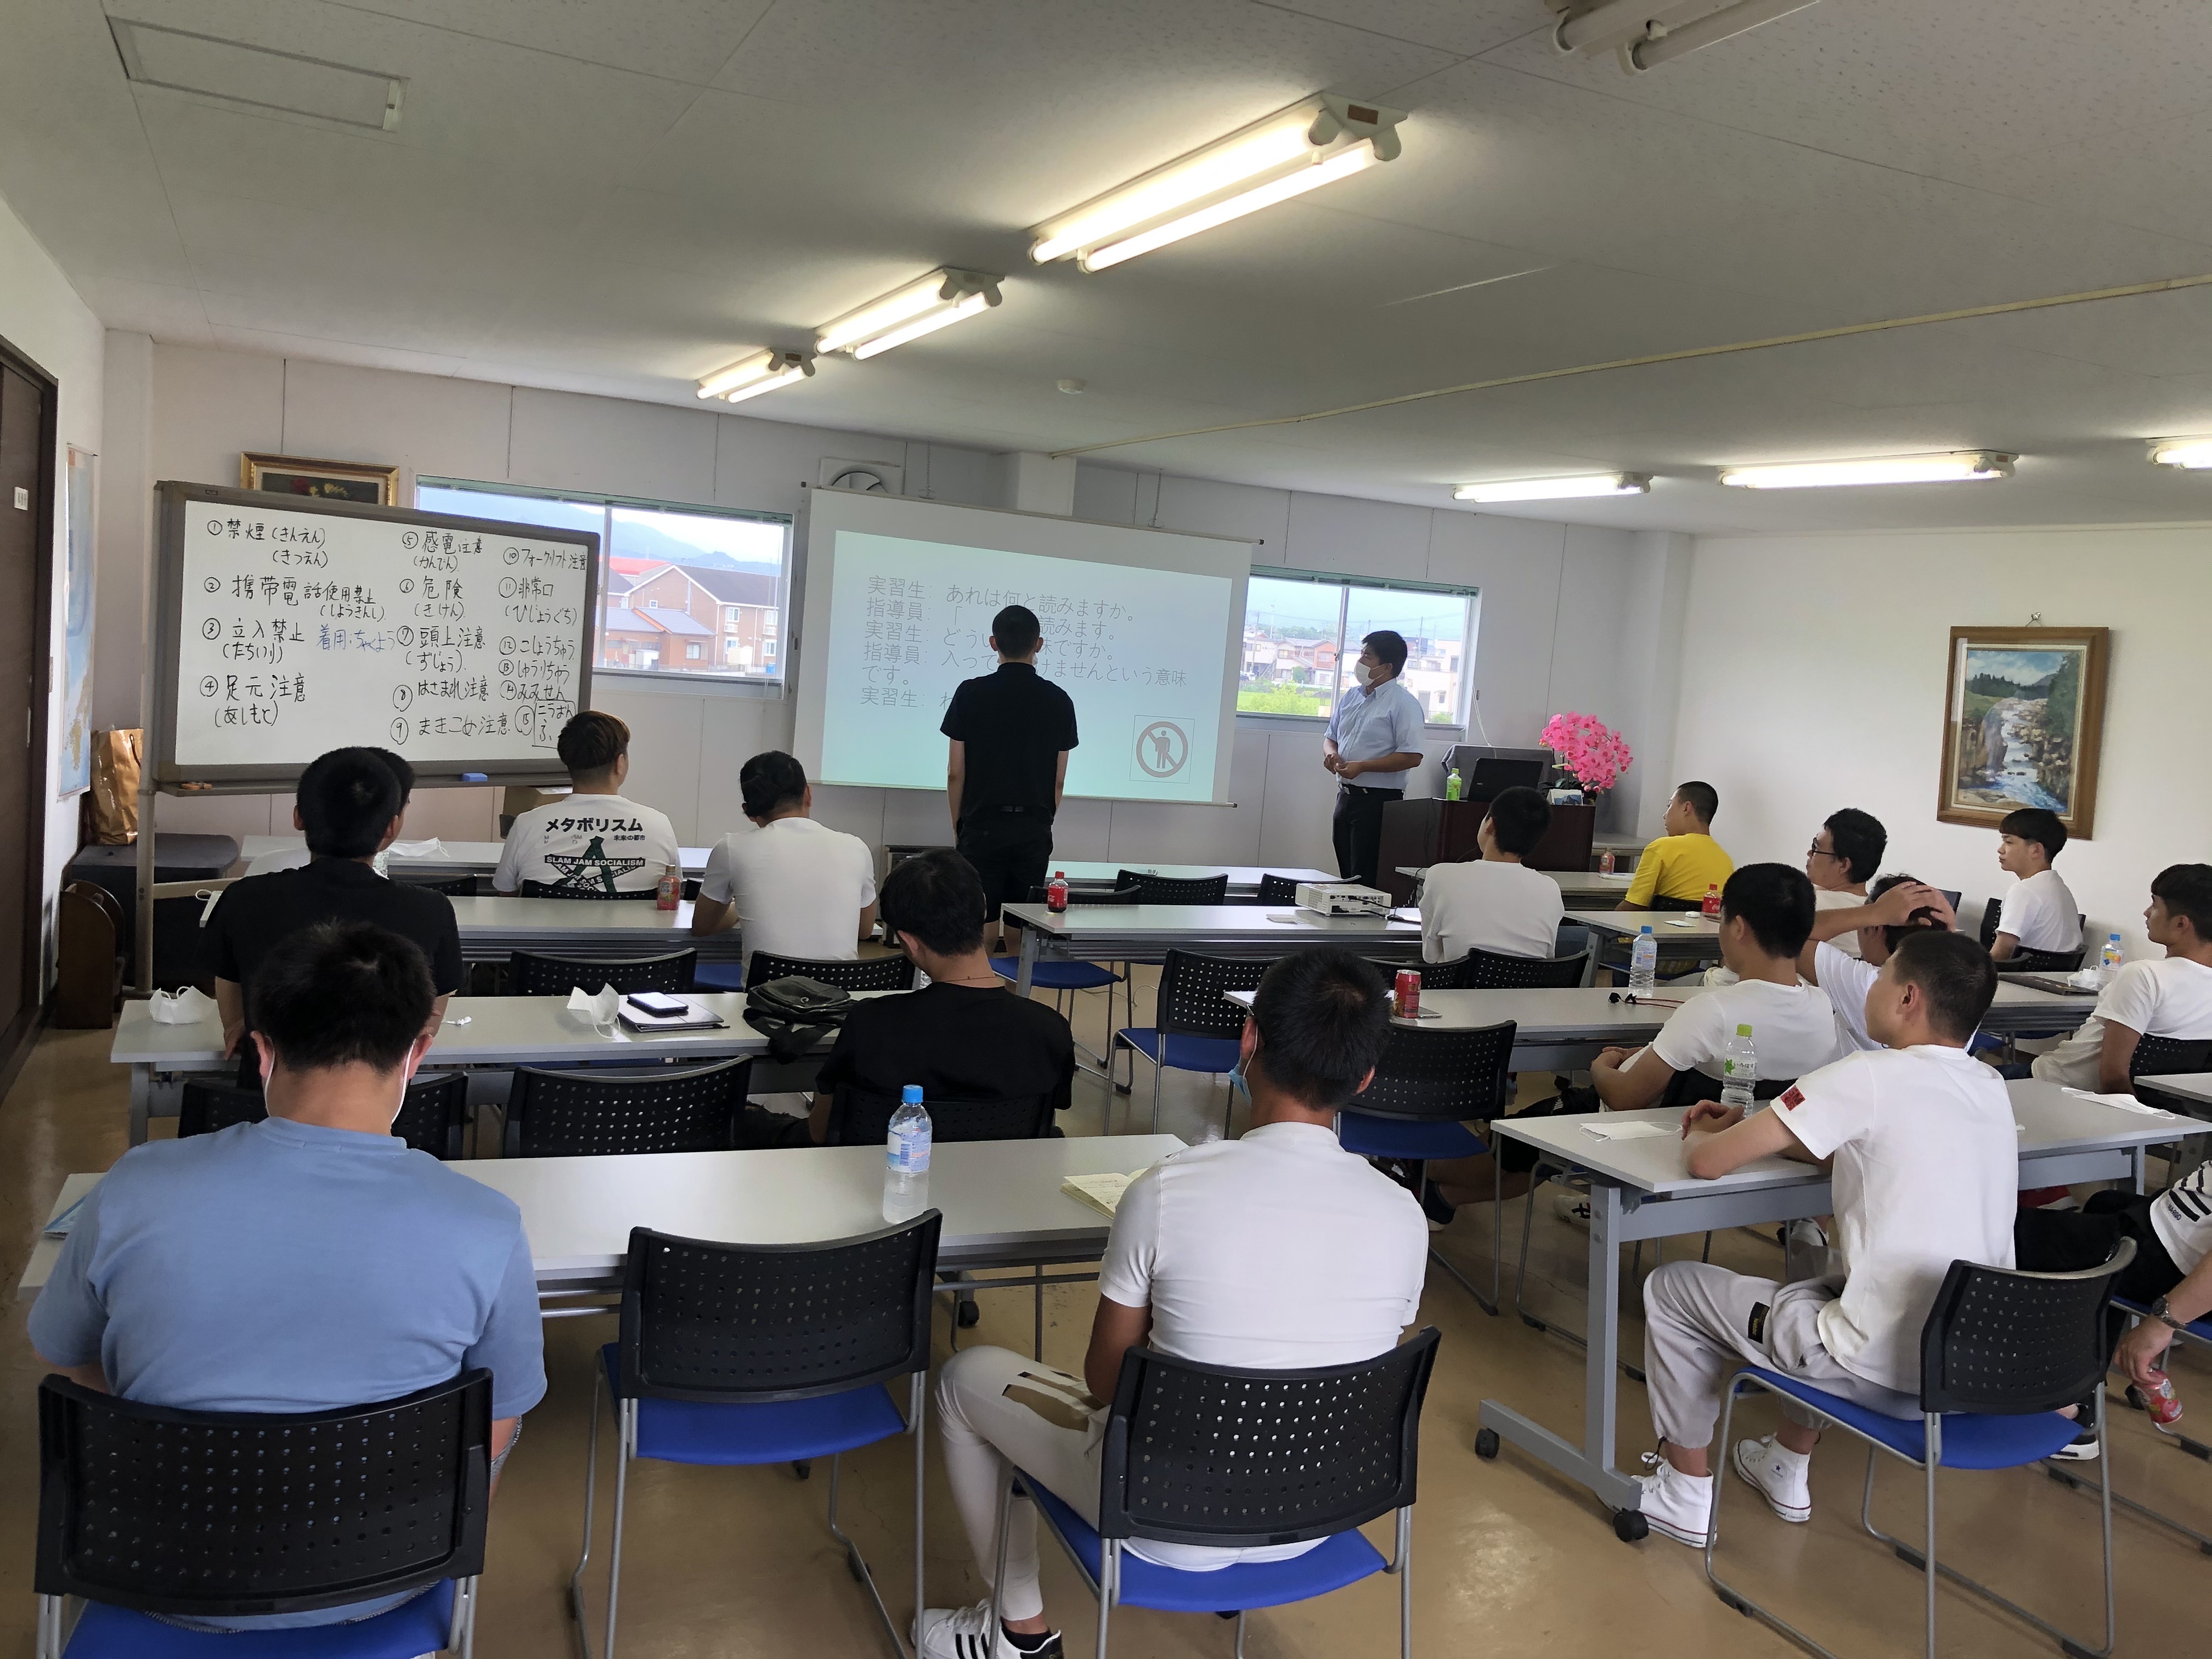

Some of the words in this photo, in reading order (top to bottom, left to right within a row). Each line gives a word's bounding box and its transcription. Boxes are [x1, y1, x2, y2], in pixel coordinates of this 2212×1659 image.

[422, 531, 482, 555] 感電注意
[422, 575, 462, 601] 危険
[518, 577, 553, 601] 非常口
[232, 617, 304, 642] 立入禁止
[420, 625, 486, 650] 頭上注意
[226, 672, 305, 702] 足元注意
[862, 665, 909, 685] です。
[418, 675, 488, 701] はさまれ注意
[546, 817, 643, 833] メタボリスム
